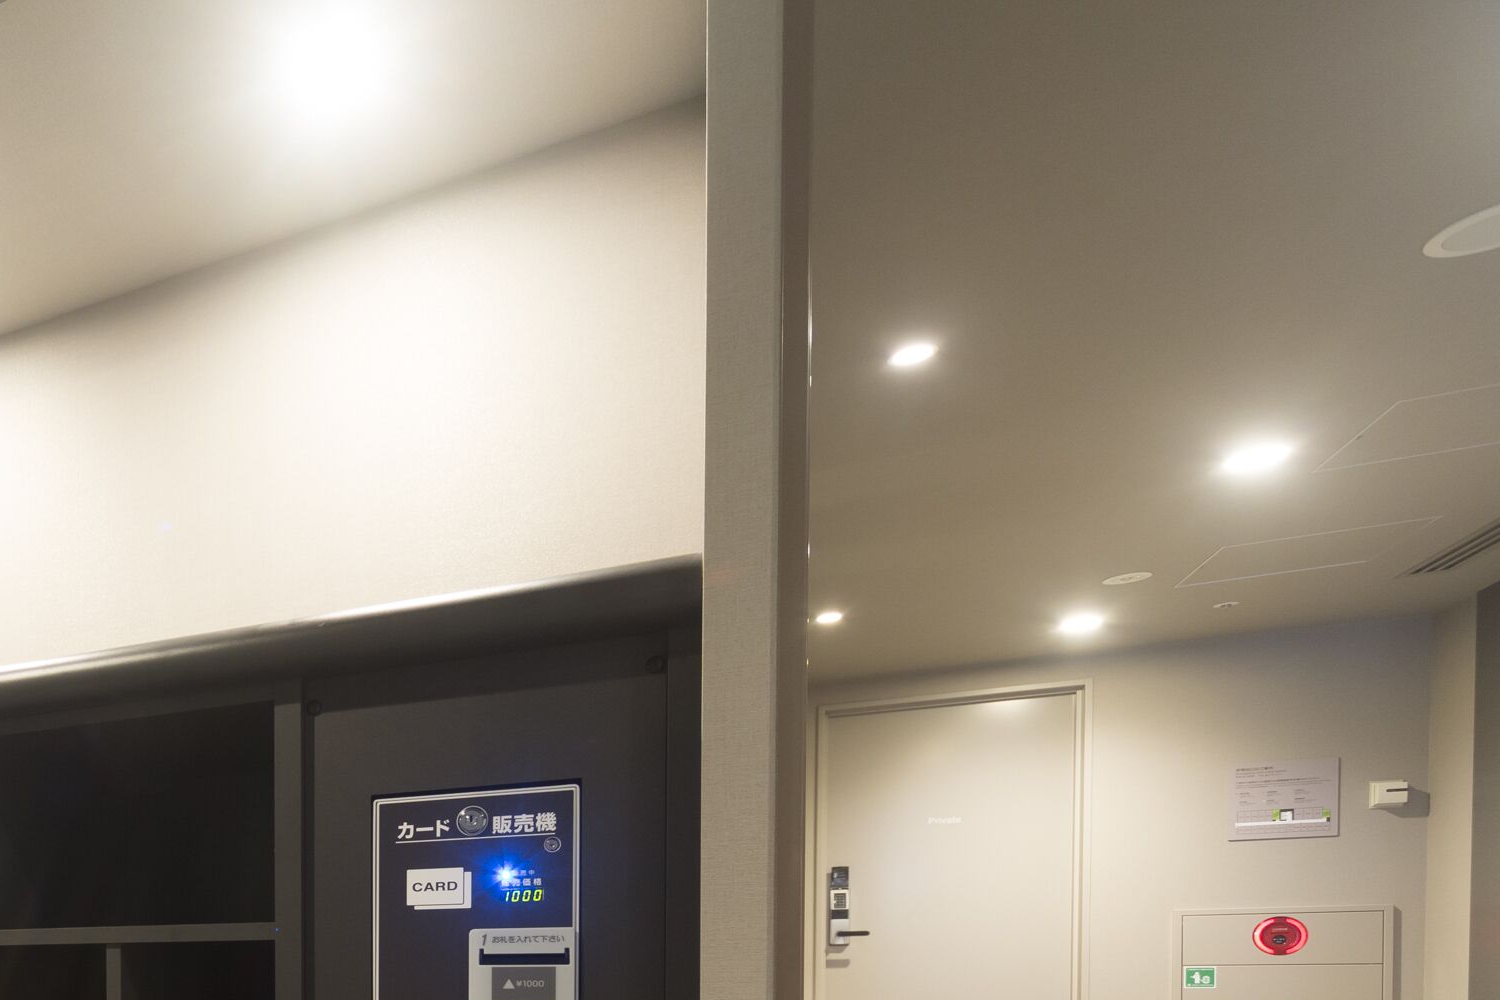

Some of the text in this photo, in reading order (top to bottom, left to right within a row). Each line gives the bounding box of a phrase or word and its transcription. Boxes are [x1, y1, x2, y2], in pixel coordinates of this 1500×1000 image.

[397, 812, 557, 839] カード 販売機
[412, 881, 458, 892] CARD
[505, 889, 543, 902] 1000
[481, 934, 565, 946] 1 お札を入れて下さい
[516, 980, 545, 988] ¥1000
